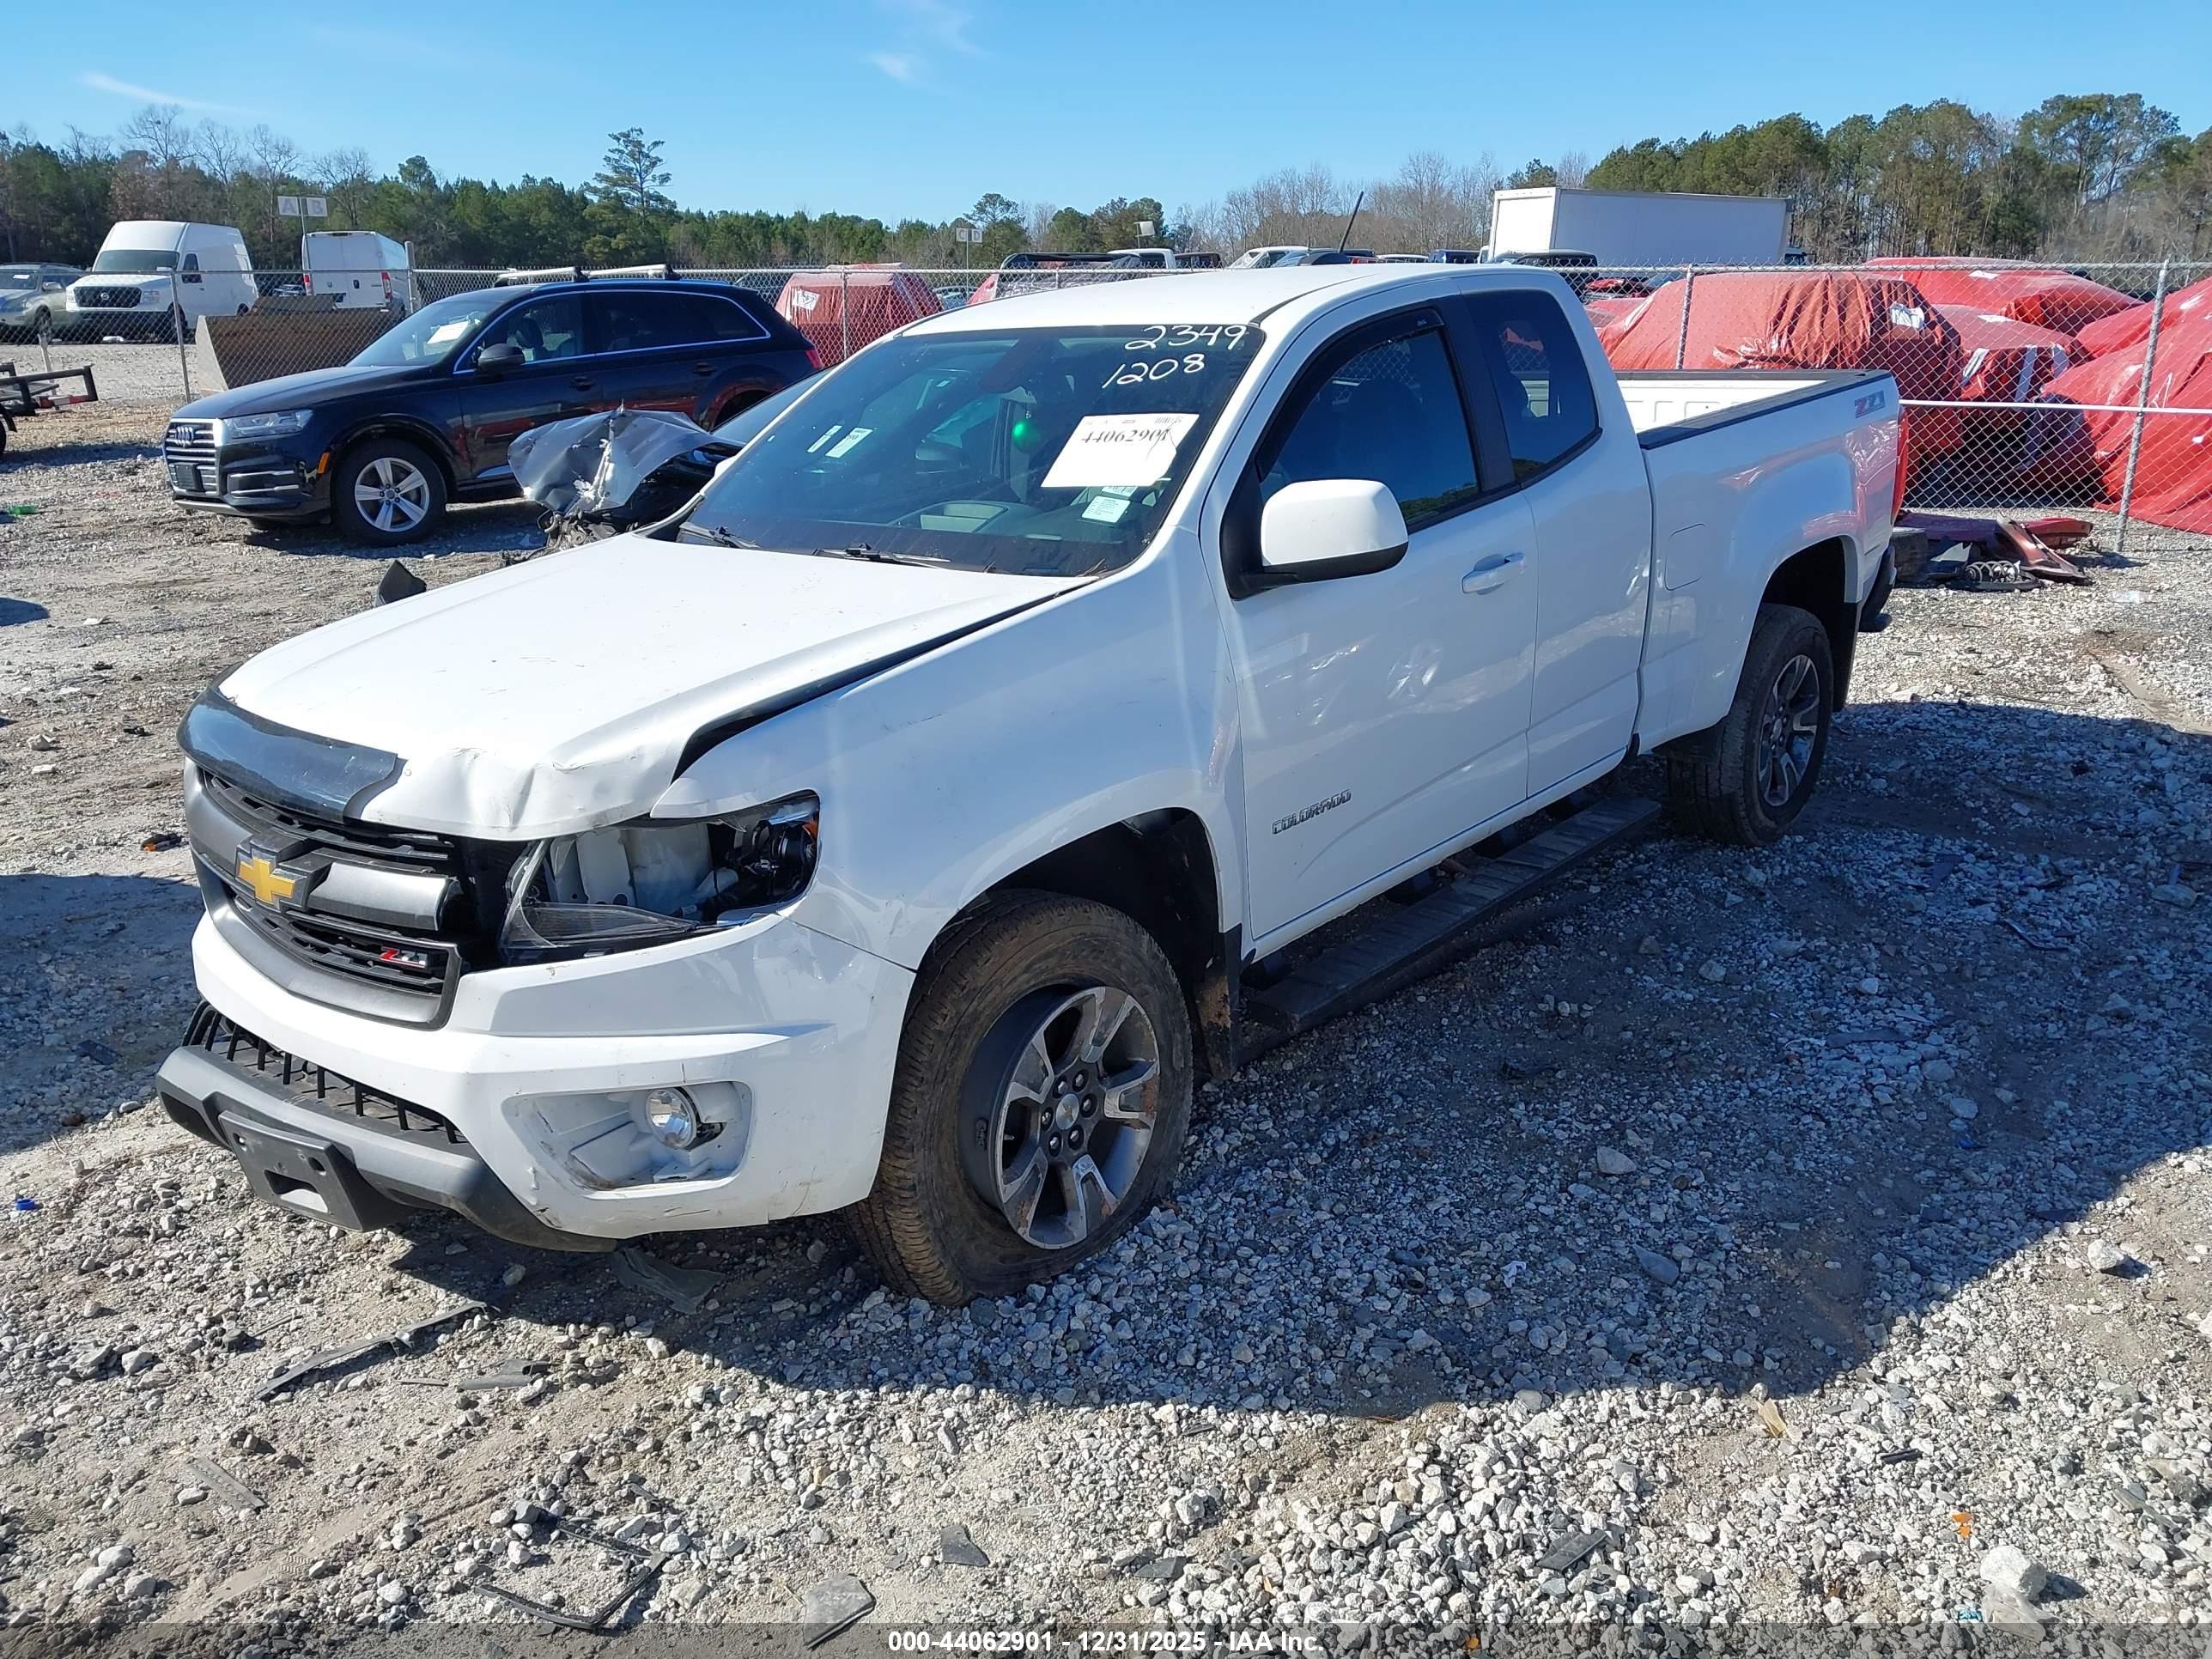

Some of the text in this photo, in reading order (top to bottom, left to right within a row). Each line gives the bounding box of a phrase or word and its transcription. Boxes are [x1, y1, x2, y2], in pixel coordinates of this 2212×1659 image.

[282, 198, 296, 214] A
[312, 199, 324, 214] B
[1124, 325, 1248, 350] 2349
[1101, 353, 1206, 389] 1208
[1854, 390, 1886, 419] Z71
[1273, 788, 1352, 835] COLORADO
[379, 946, 428, 969] Z71
